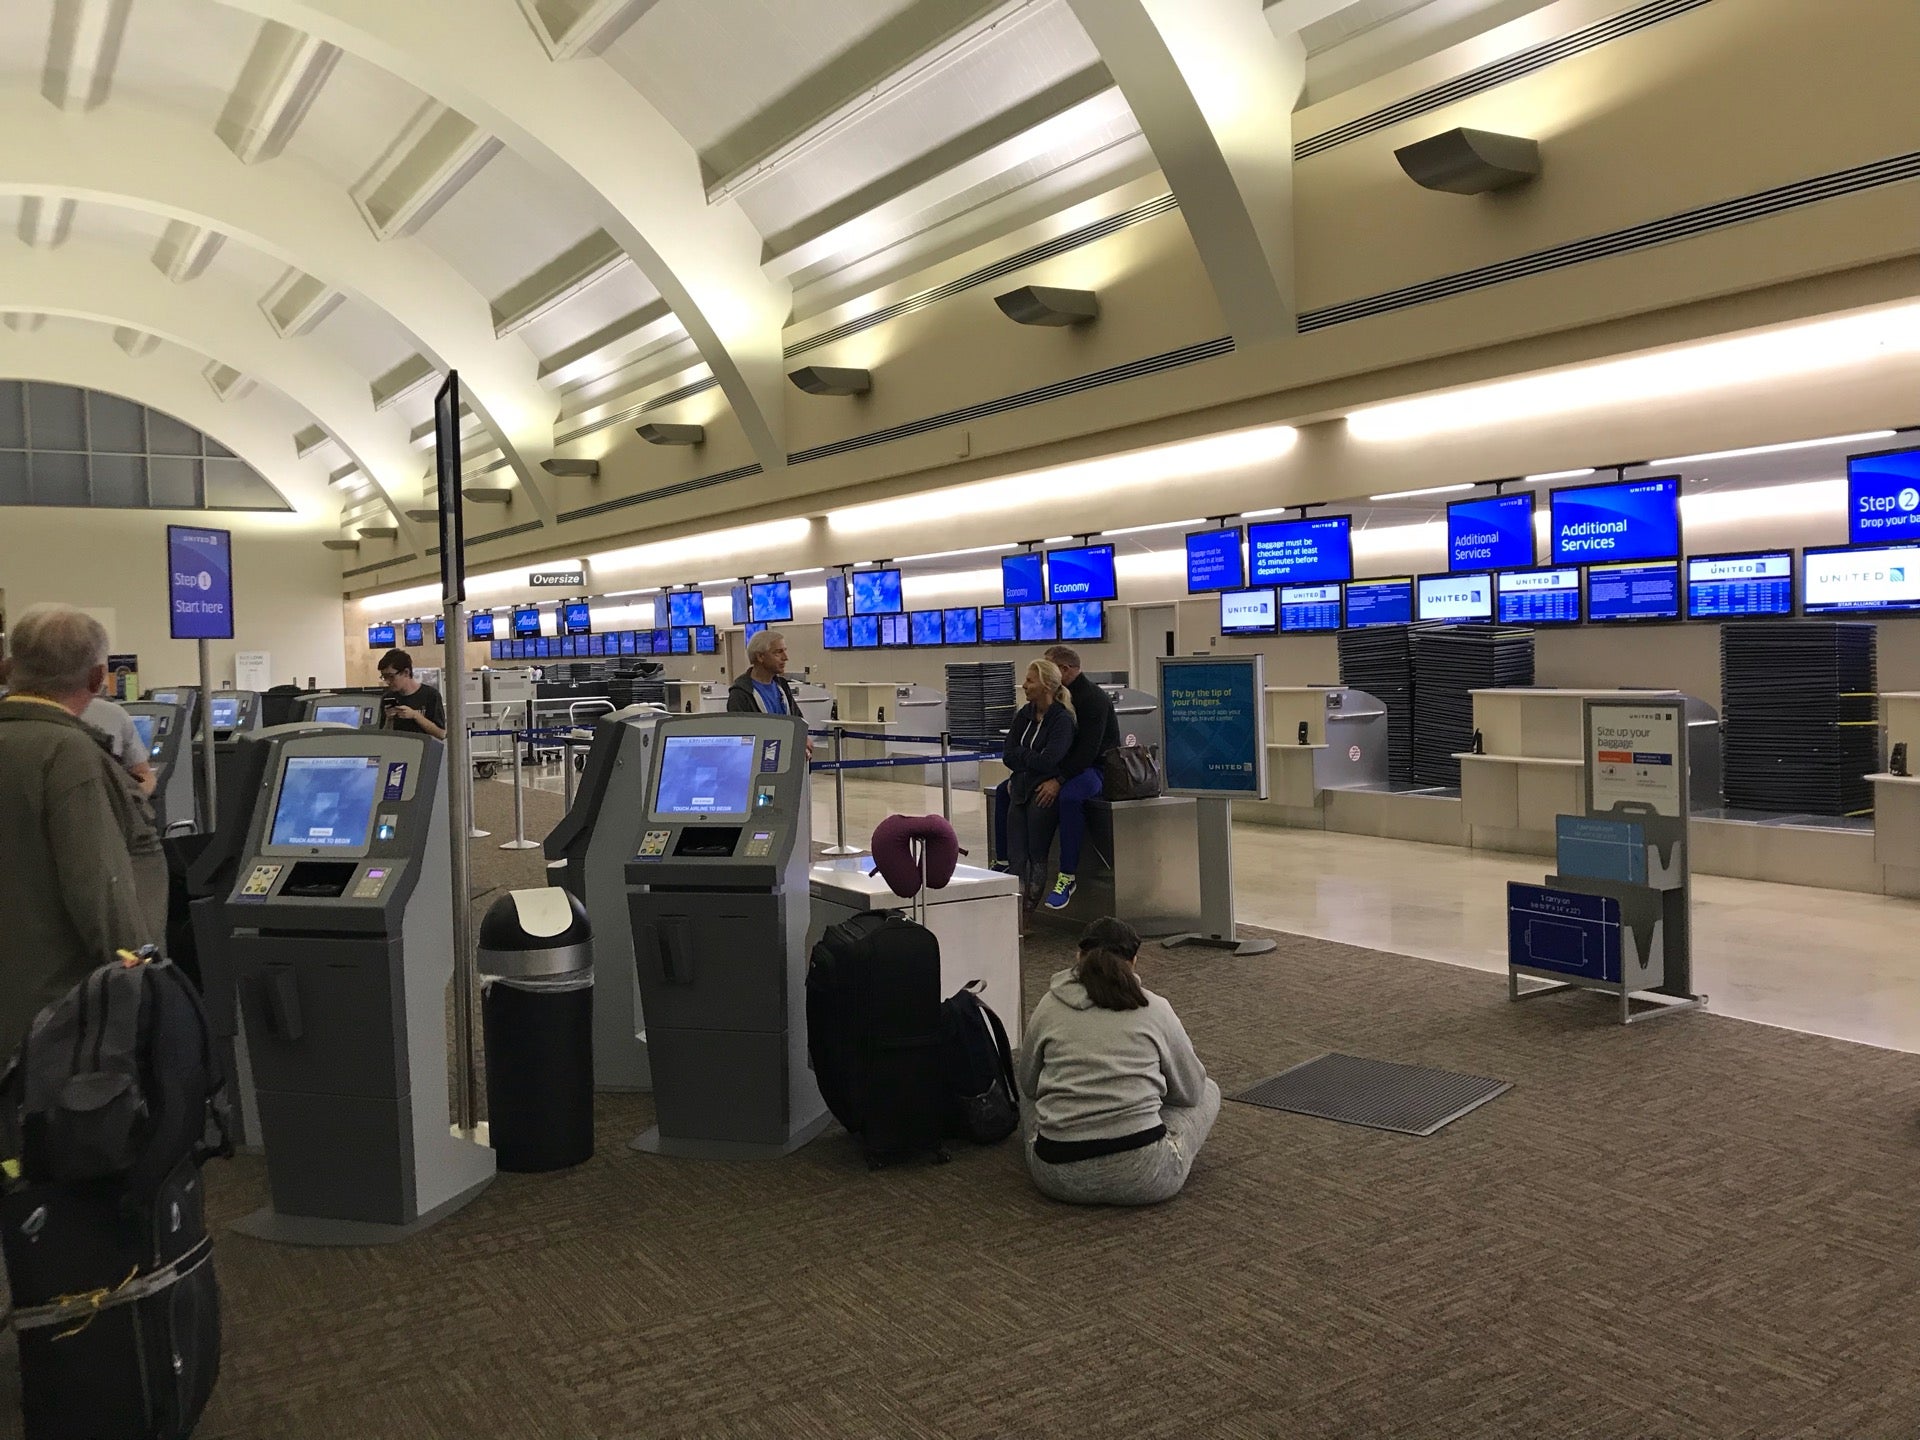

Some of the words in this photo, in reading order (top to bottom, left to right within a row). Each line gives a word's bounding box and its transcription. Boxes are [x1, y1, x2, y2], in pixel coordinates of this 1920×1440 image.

[1860, 496, 1896, 512] Step
[1904, 491, 1915, 507] 2
[1561, 519, 1628, 537] Additional
[1861, 518, 1884, 529] Drop
[1886, 515, 1908, 528] your
[1257, 541, 1285, 550] Baggage
[1285, 539, 1303, 547] must
[1304, 538, 1313, 546] be
[1455, 531, 1499, 547] Additional
[1561, 537, 1616, 552] Services
[1257, 549, 1284, 558] checked
[1301, 546, 1318, 555] least
[1455, 547, 1492, 561] Services
[1257, 558, 1267, 567] 45
[1267, 557, 1295, 566] minutes
[1295, 555, 1319, 564] before
[1257, 566, 1291, 575] departure
[1710, 565, 1753, 575] UNITED
[175, 573, 197, 588] Step
[533, 574, 580, 584] Oversize
[1515, 577, 1550, 586] UNITED
[1819, 571, 1885, 584] UNITED
[1006, 587, 1028, 598] Economy
[1054, 582, 1090, 593] Economy
[1293, 591, 1319, 599] UNITED
[1427, 594, 1469, 604] UNITED
[176, 600, 200, 613] Start
[201, 600, 224, 614] here
[1227, 605, 1259, 614] UNITED
[1172, 689, 1185, 699] Fly
[1185, 690, 1196, 698] by
[1197, 689, 1210, 697] the
[1211, 689, 1223, 698] tip
[1223, 688, 1232, 697] of
[1172, 699, 1190, 707] your
[1192, 698, 1222, 707] fingers.
[1597, 726, 1615, 737] Size
[1616, 728, 1629, 738] up
[1630, 729, 1651, 739] your
[1597, 738, 1634, 750] baggage
